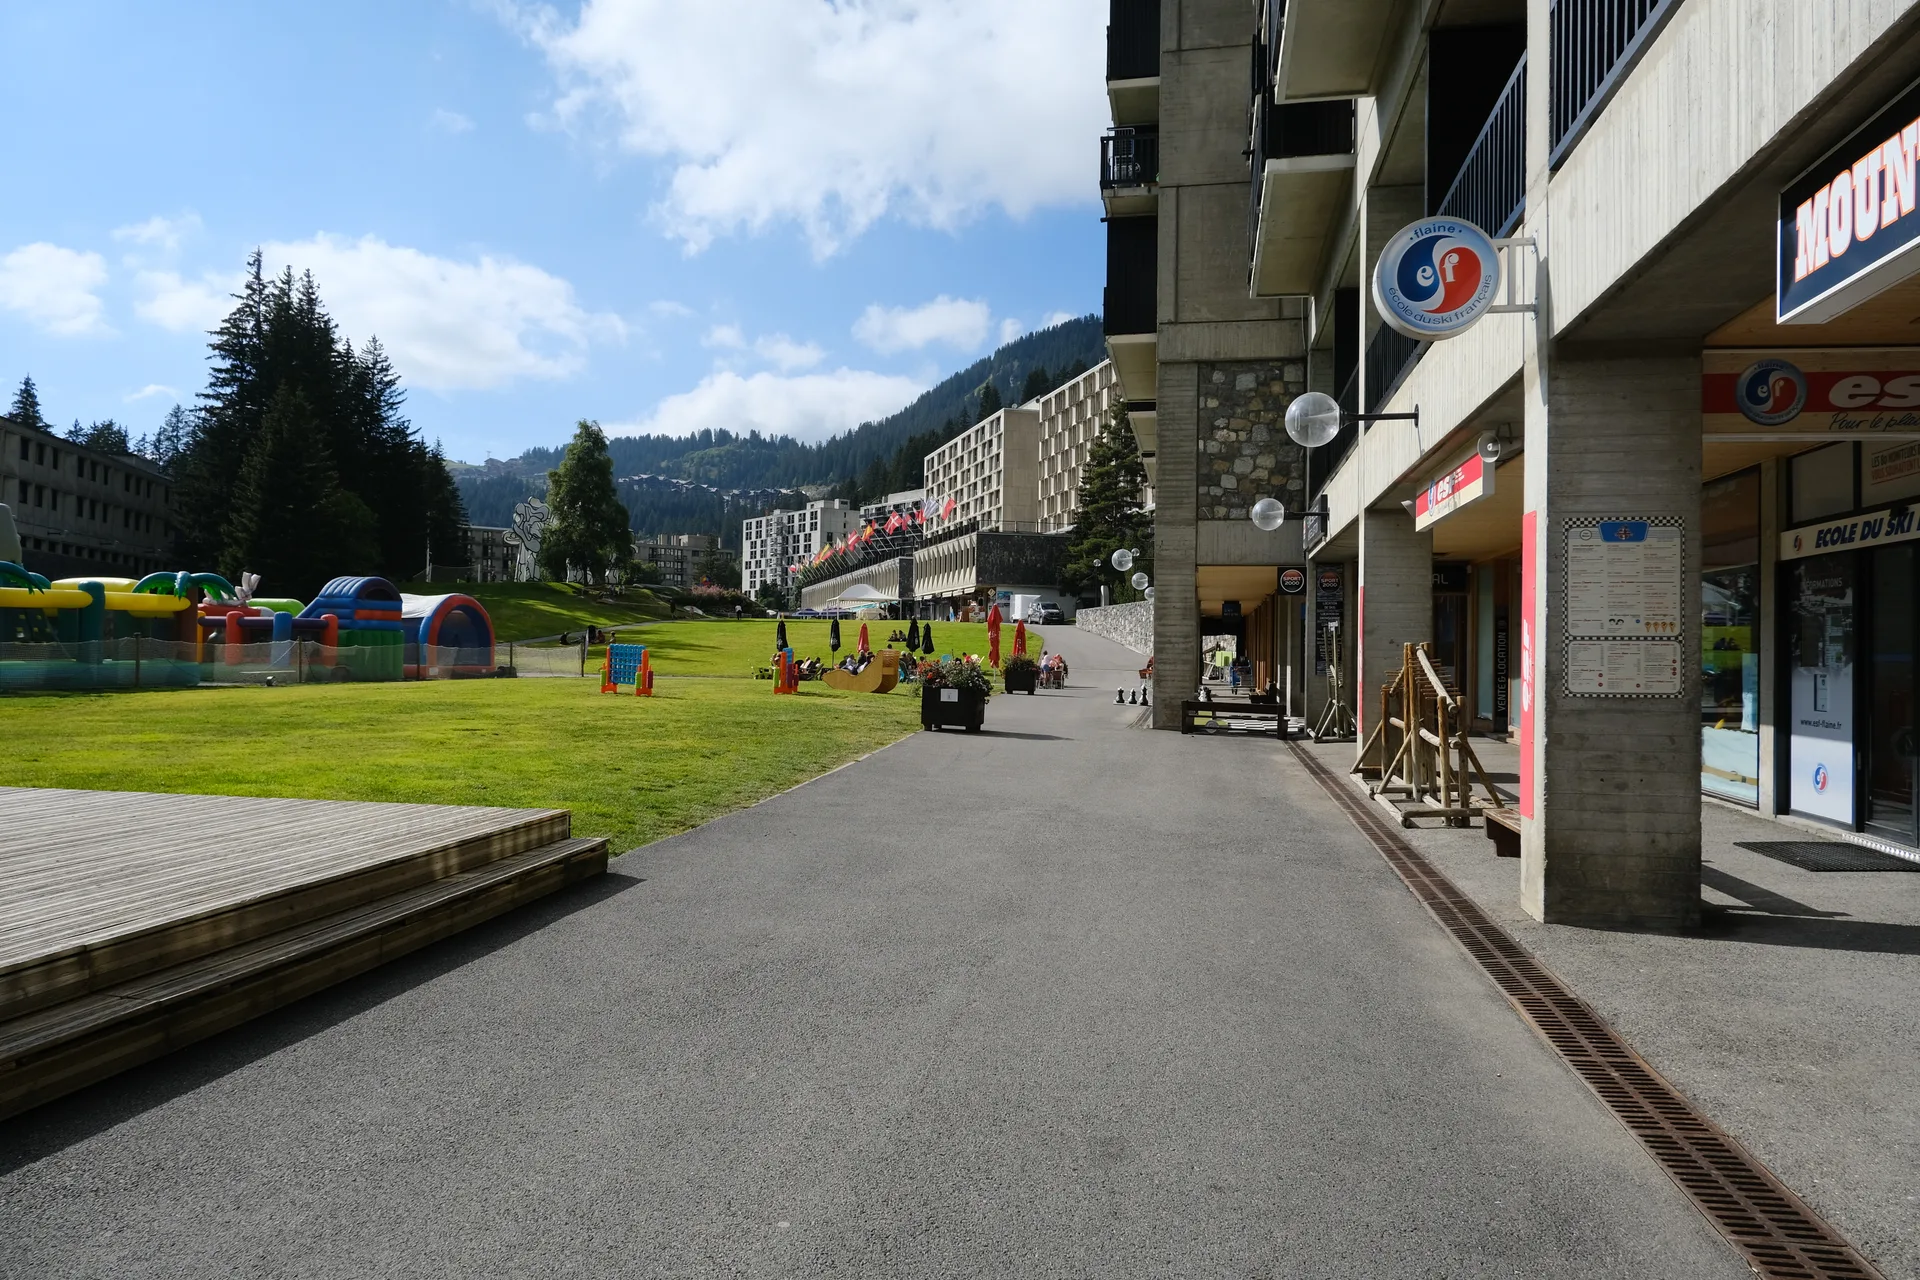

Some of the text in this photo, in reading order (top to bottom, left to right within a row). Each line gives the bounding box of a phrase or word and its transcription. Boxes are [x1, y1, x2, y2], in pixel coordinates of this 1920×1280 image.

[1794, 118, 1920, 283] MOUN
[1413, 223, 1456, 239] flaine
[1388, 274, 1493, 325] école du ski français
[1828, 411, 1868, 430] Pour
[1870, 411, 1884, 429] le
[1815, 510, 1915, 549] ECOLE DU SKI
[1497, 632, 1506, 675] LOCATION
[1497, 684, 1506, 712] VENTE
